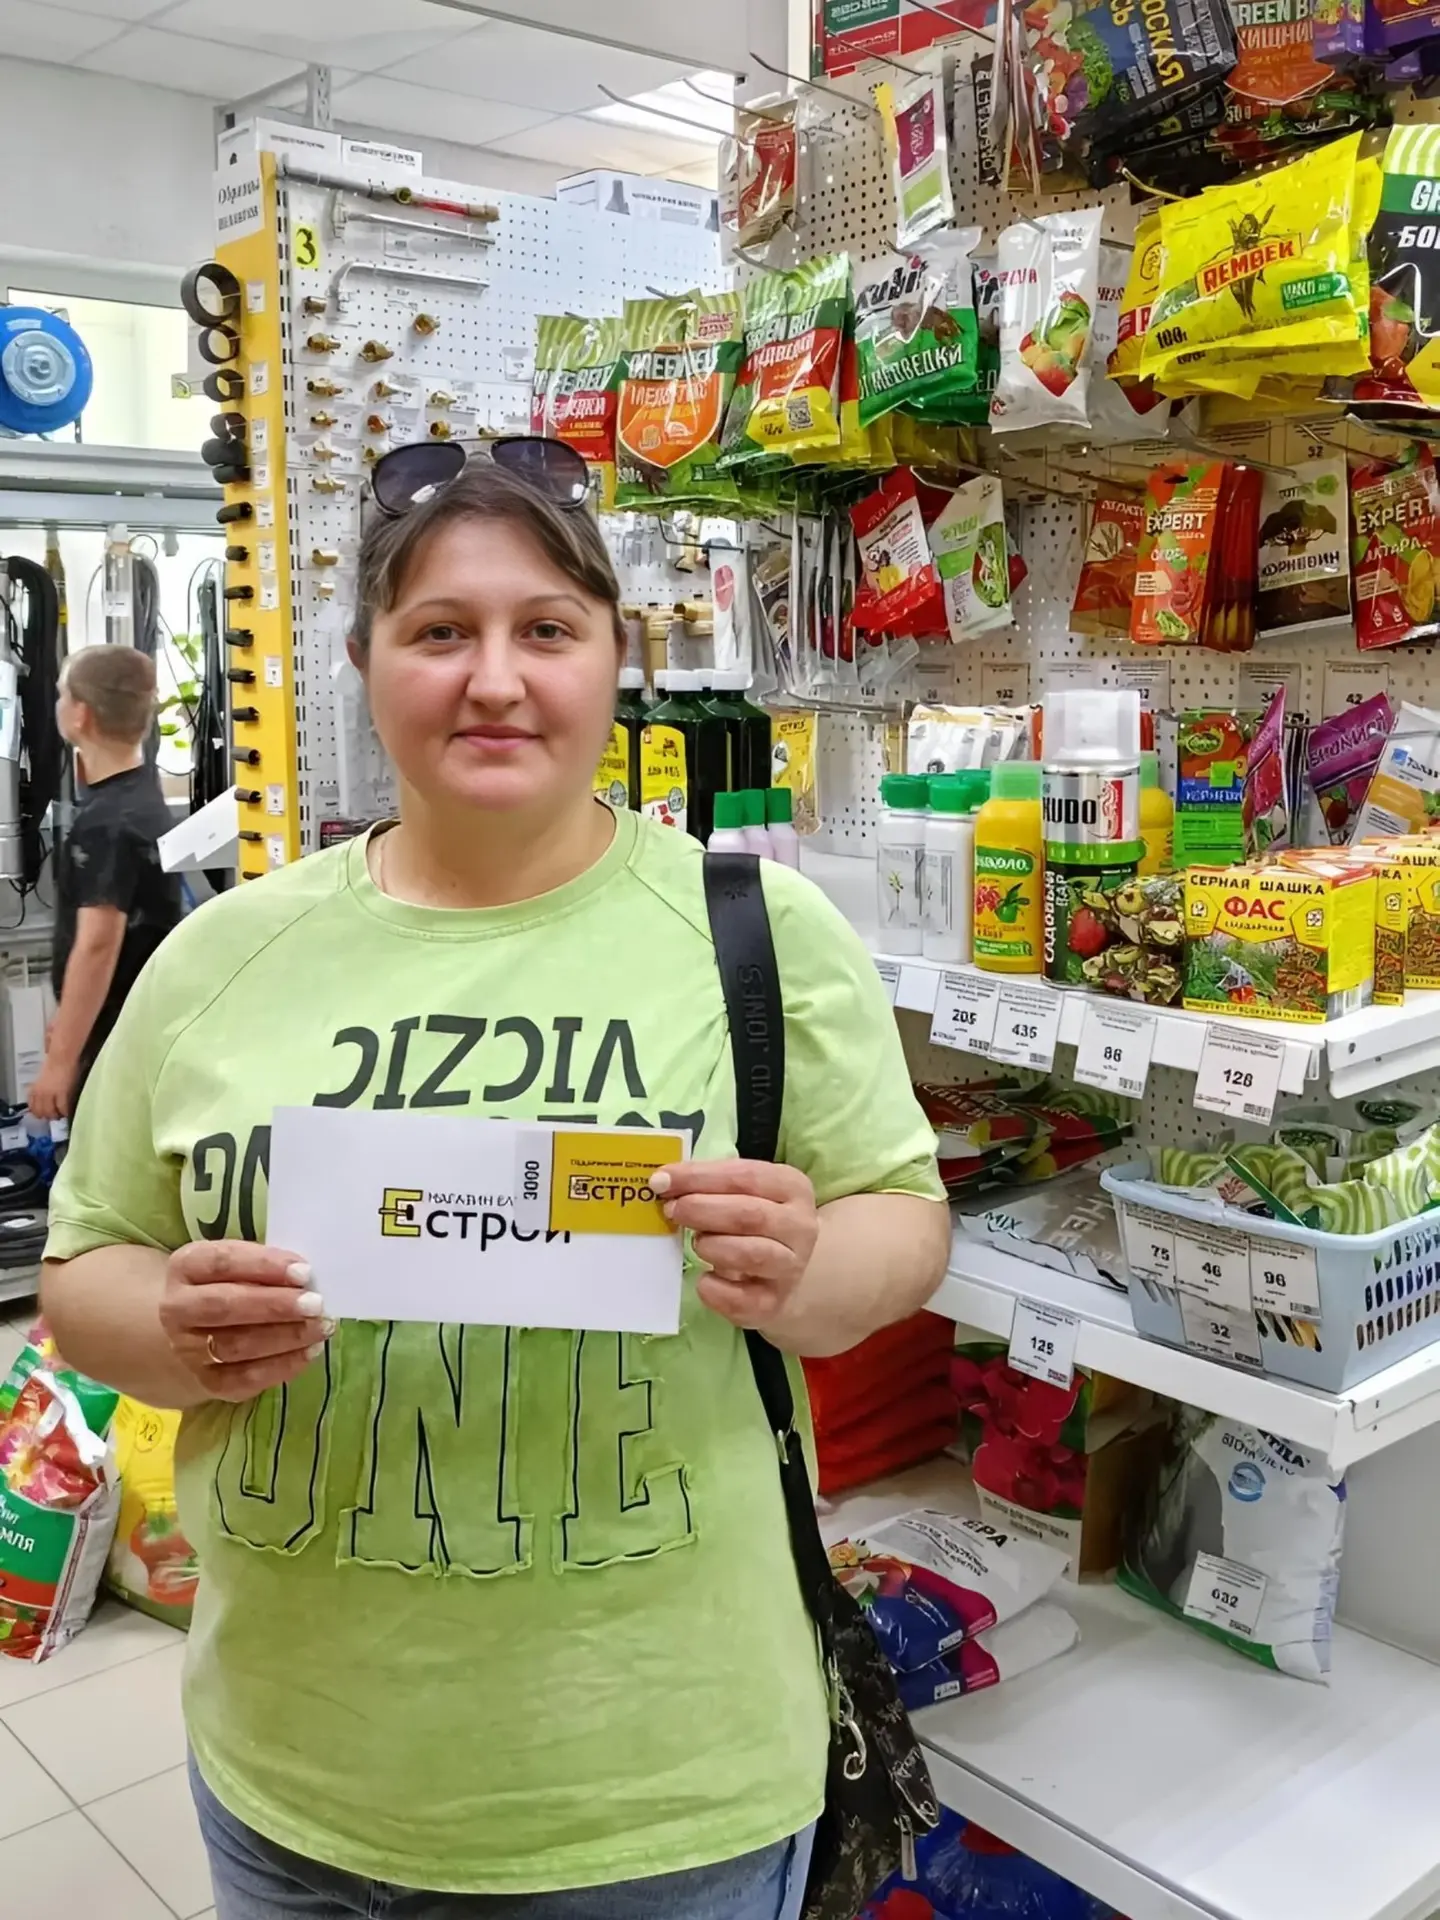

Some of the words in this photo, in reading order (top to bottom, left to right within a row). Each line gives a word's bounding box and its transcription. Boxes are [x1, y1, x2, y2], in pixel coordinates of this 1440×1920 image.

[296, 228, 316, 265] 3
[1146, 511, 1208, 533] EXPERT
[1391, 854, 1437, 867] АШК
[1190, 874, 1251, 891] СЕРНАЯ
[1259, 879, 1326, 897] ШАШКА
[1224, 896, 1286, 921] ФАС
[523, 1160, 540, 1200] 3000
